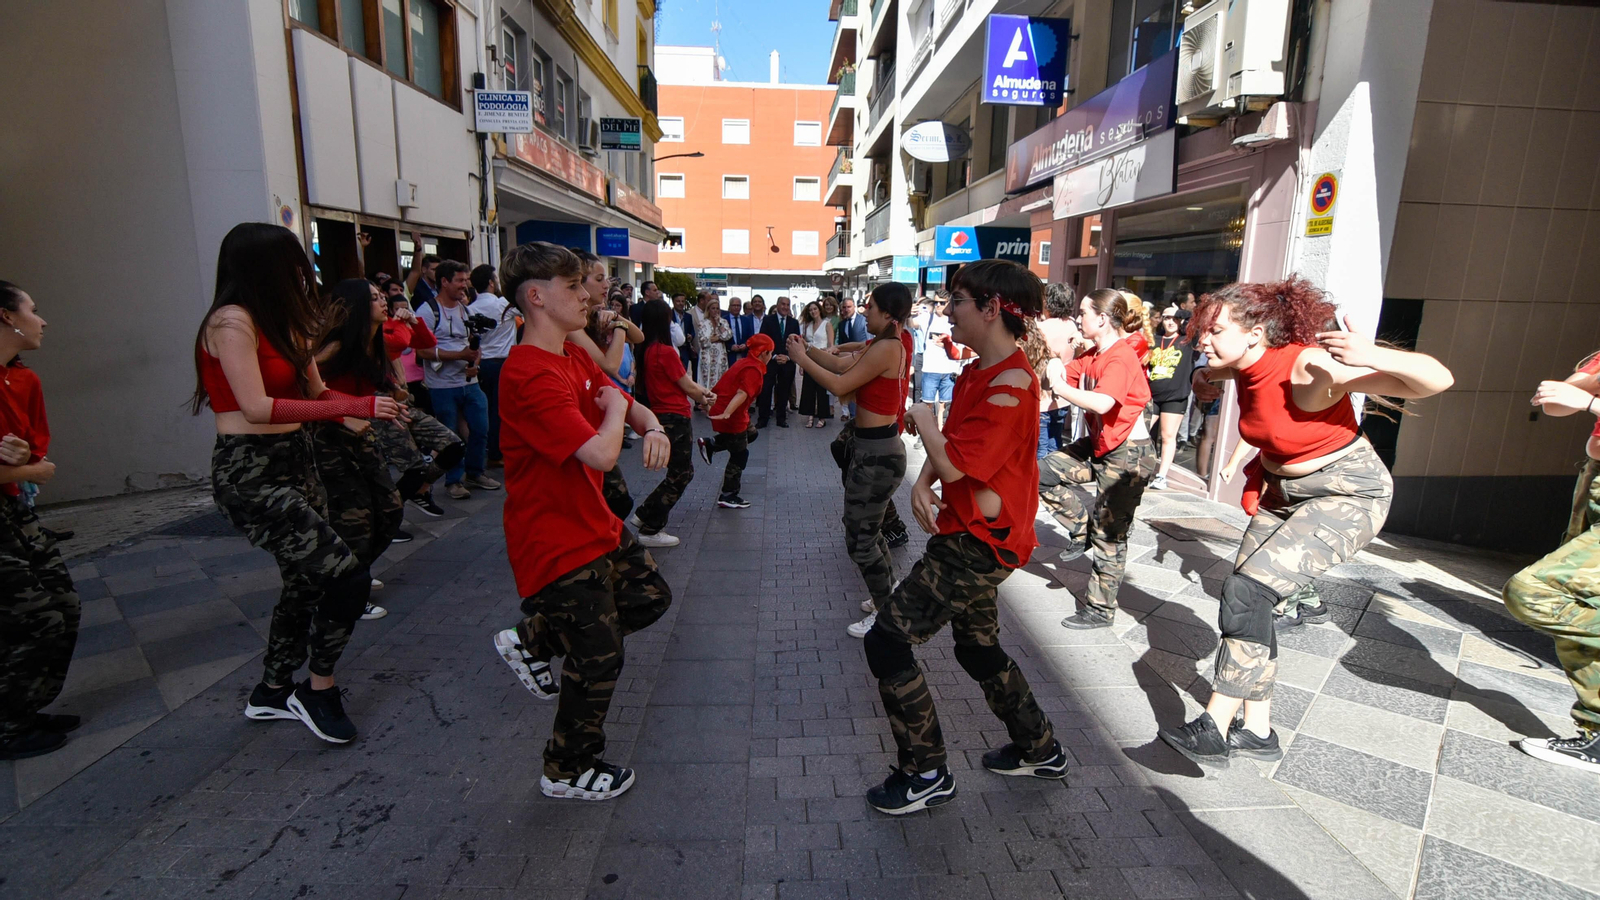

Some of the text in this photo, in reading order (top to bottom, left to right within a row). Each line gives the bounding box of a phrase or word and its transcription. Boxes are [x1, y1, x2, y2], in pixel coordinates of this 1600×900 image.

[993, 75, 1056, 91] Almudena
[478, 94, 513, 102] CLINICA
[992, 89, 1055, 100] seguros
[478, 102, 528, 110] PODOLOGIA
[602, 123, 621, 131] DEL
[1030, 105, 1163, 174] Almudena seguros
